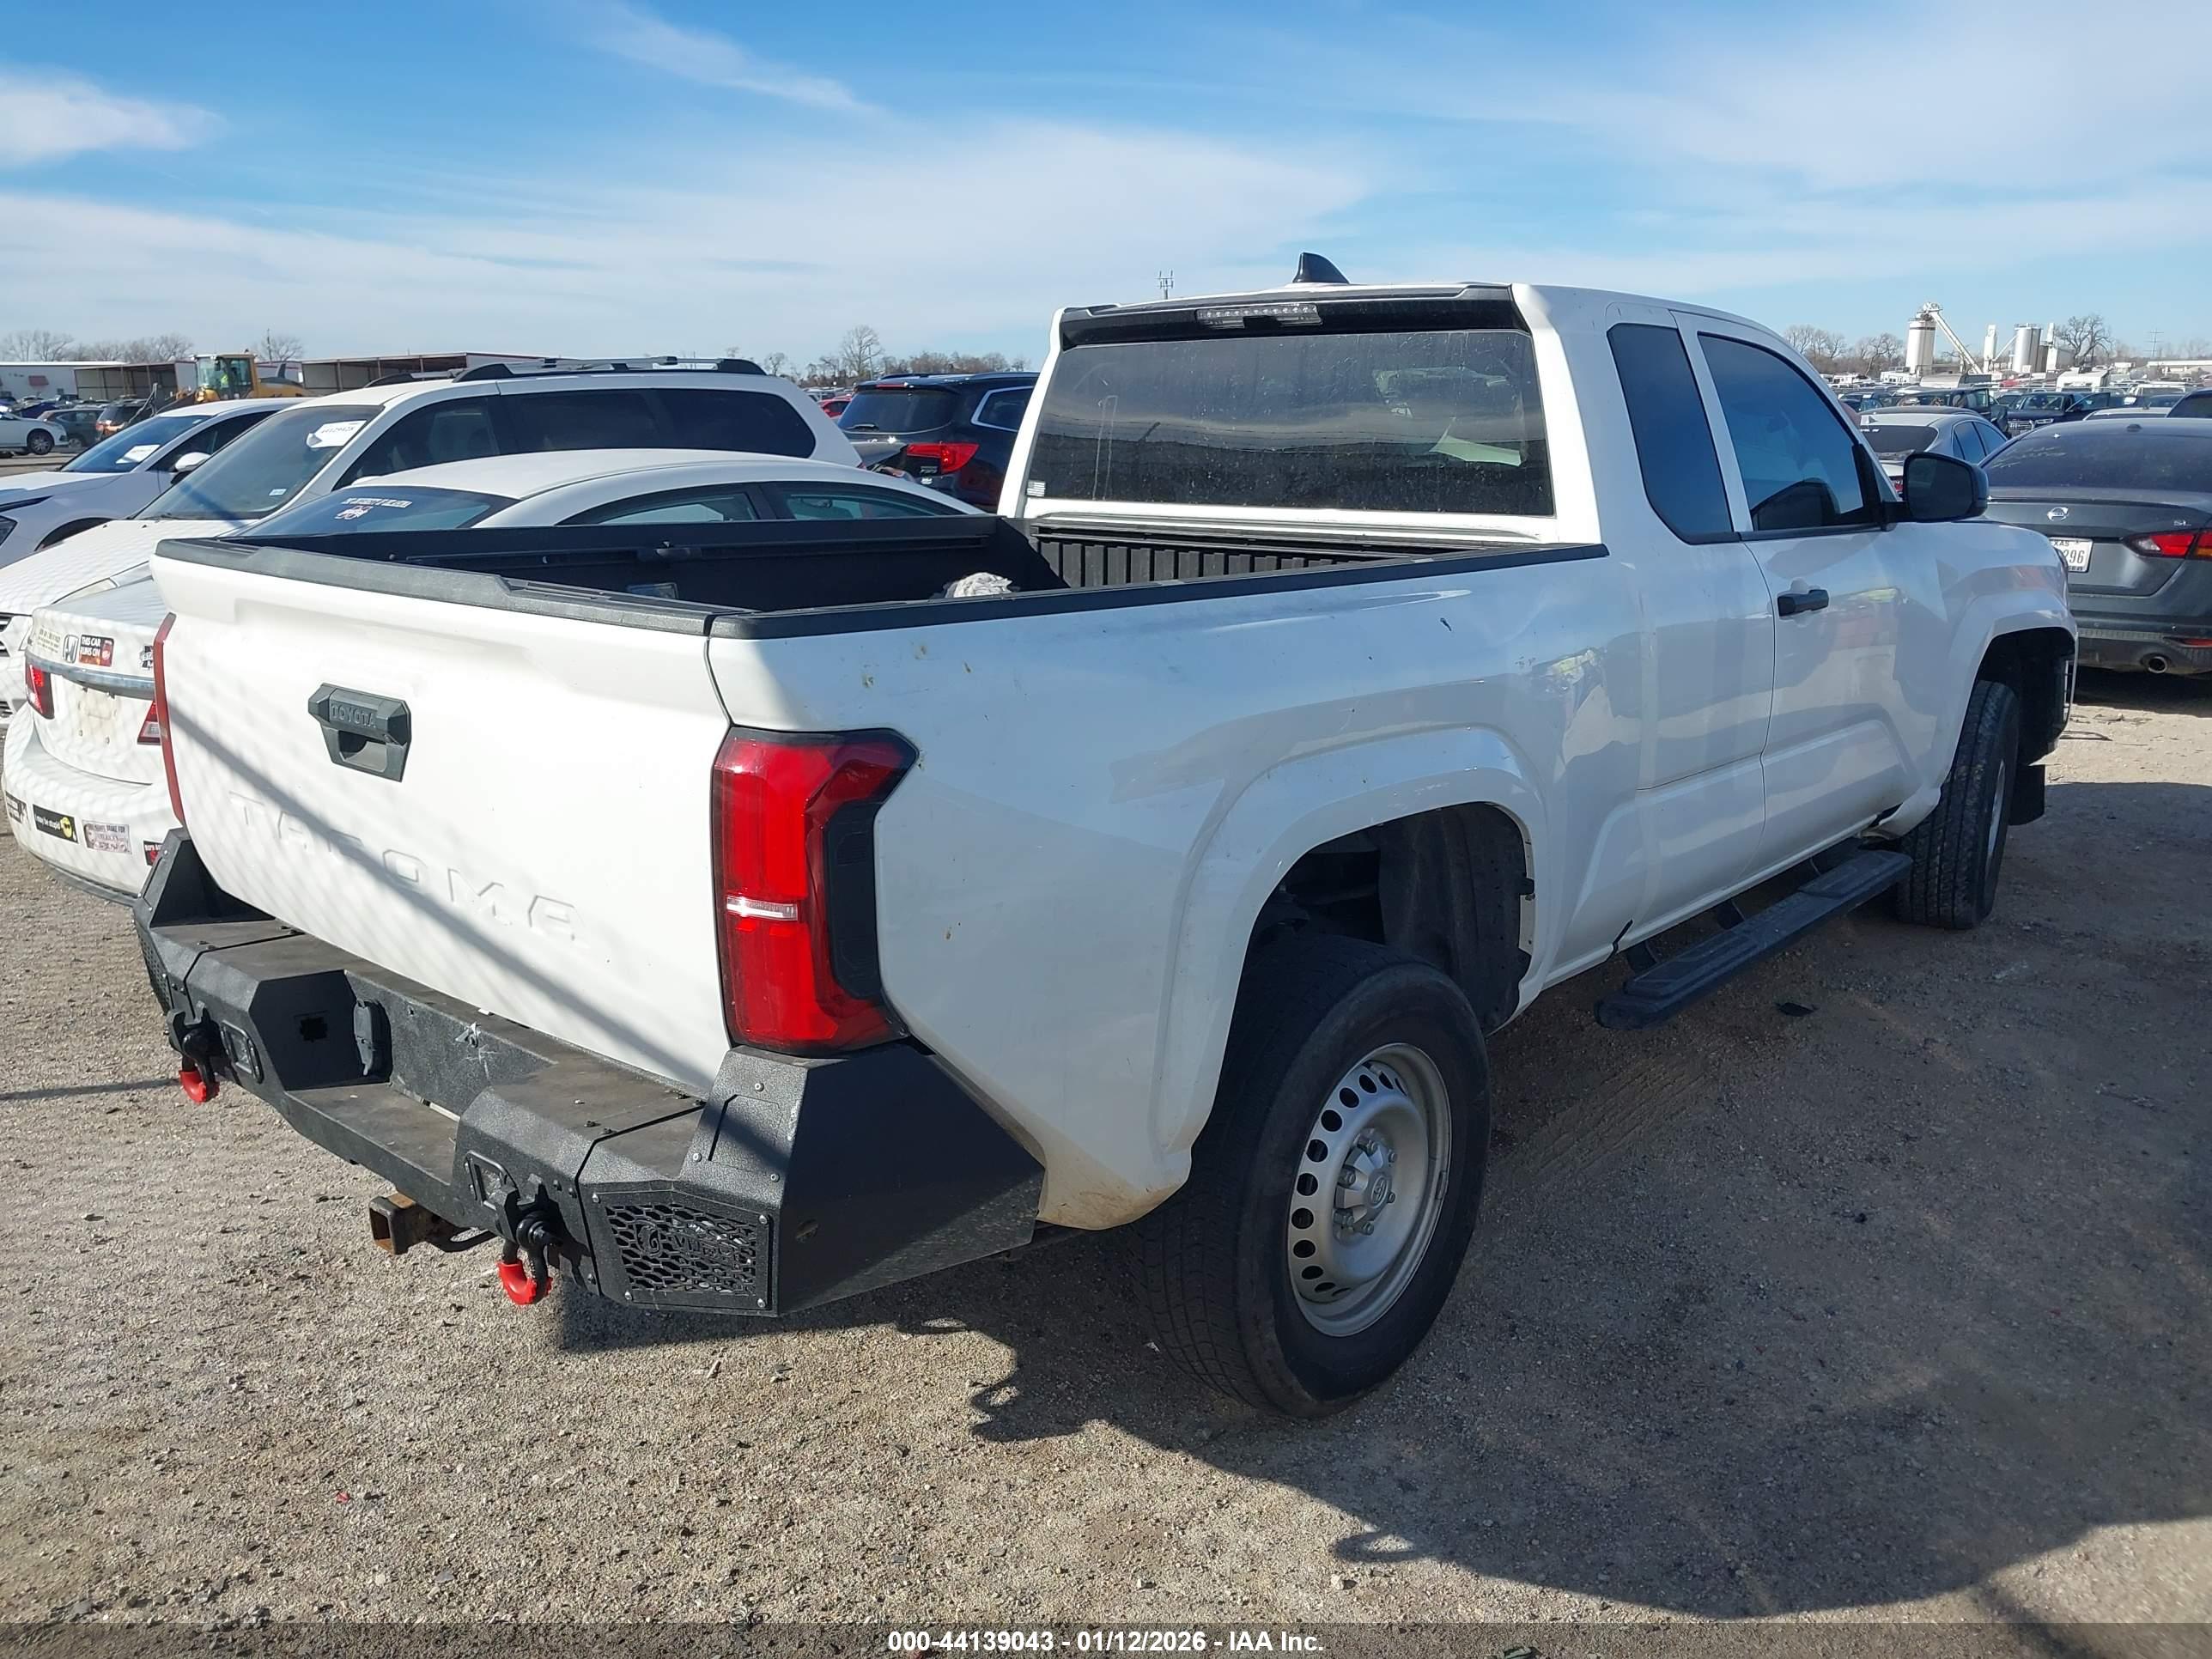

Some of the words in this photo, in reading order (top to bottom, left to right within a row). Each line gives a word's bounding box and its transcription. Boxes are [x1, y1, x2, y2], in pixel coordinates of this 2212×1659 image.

[81, 636, 90, 646] THIS
[91, 638, 101, 647] CAR
[80, 647, 92, 655] RUNS
[93, 648, 101, 657] ON
[331, 702, 376, 728] TOYOTA
[228, 790, 585, 942] TACOMA
